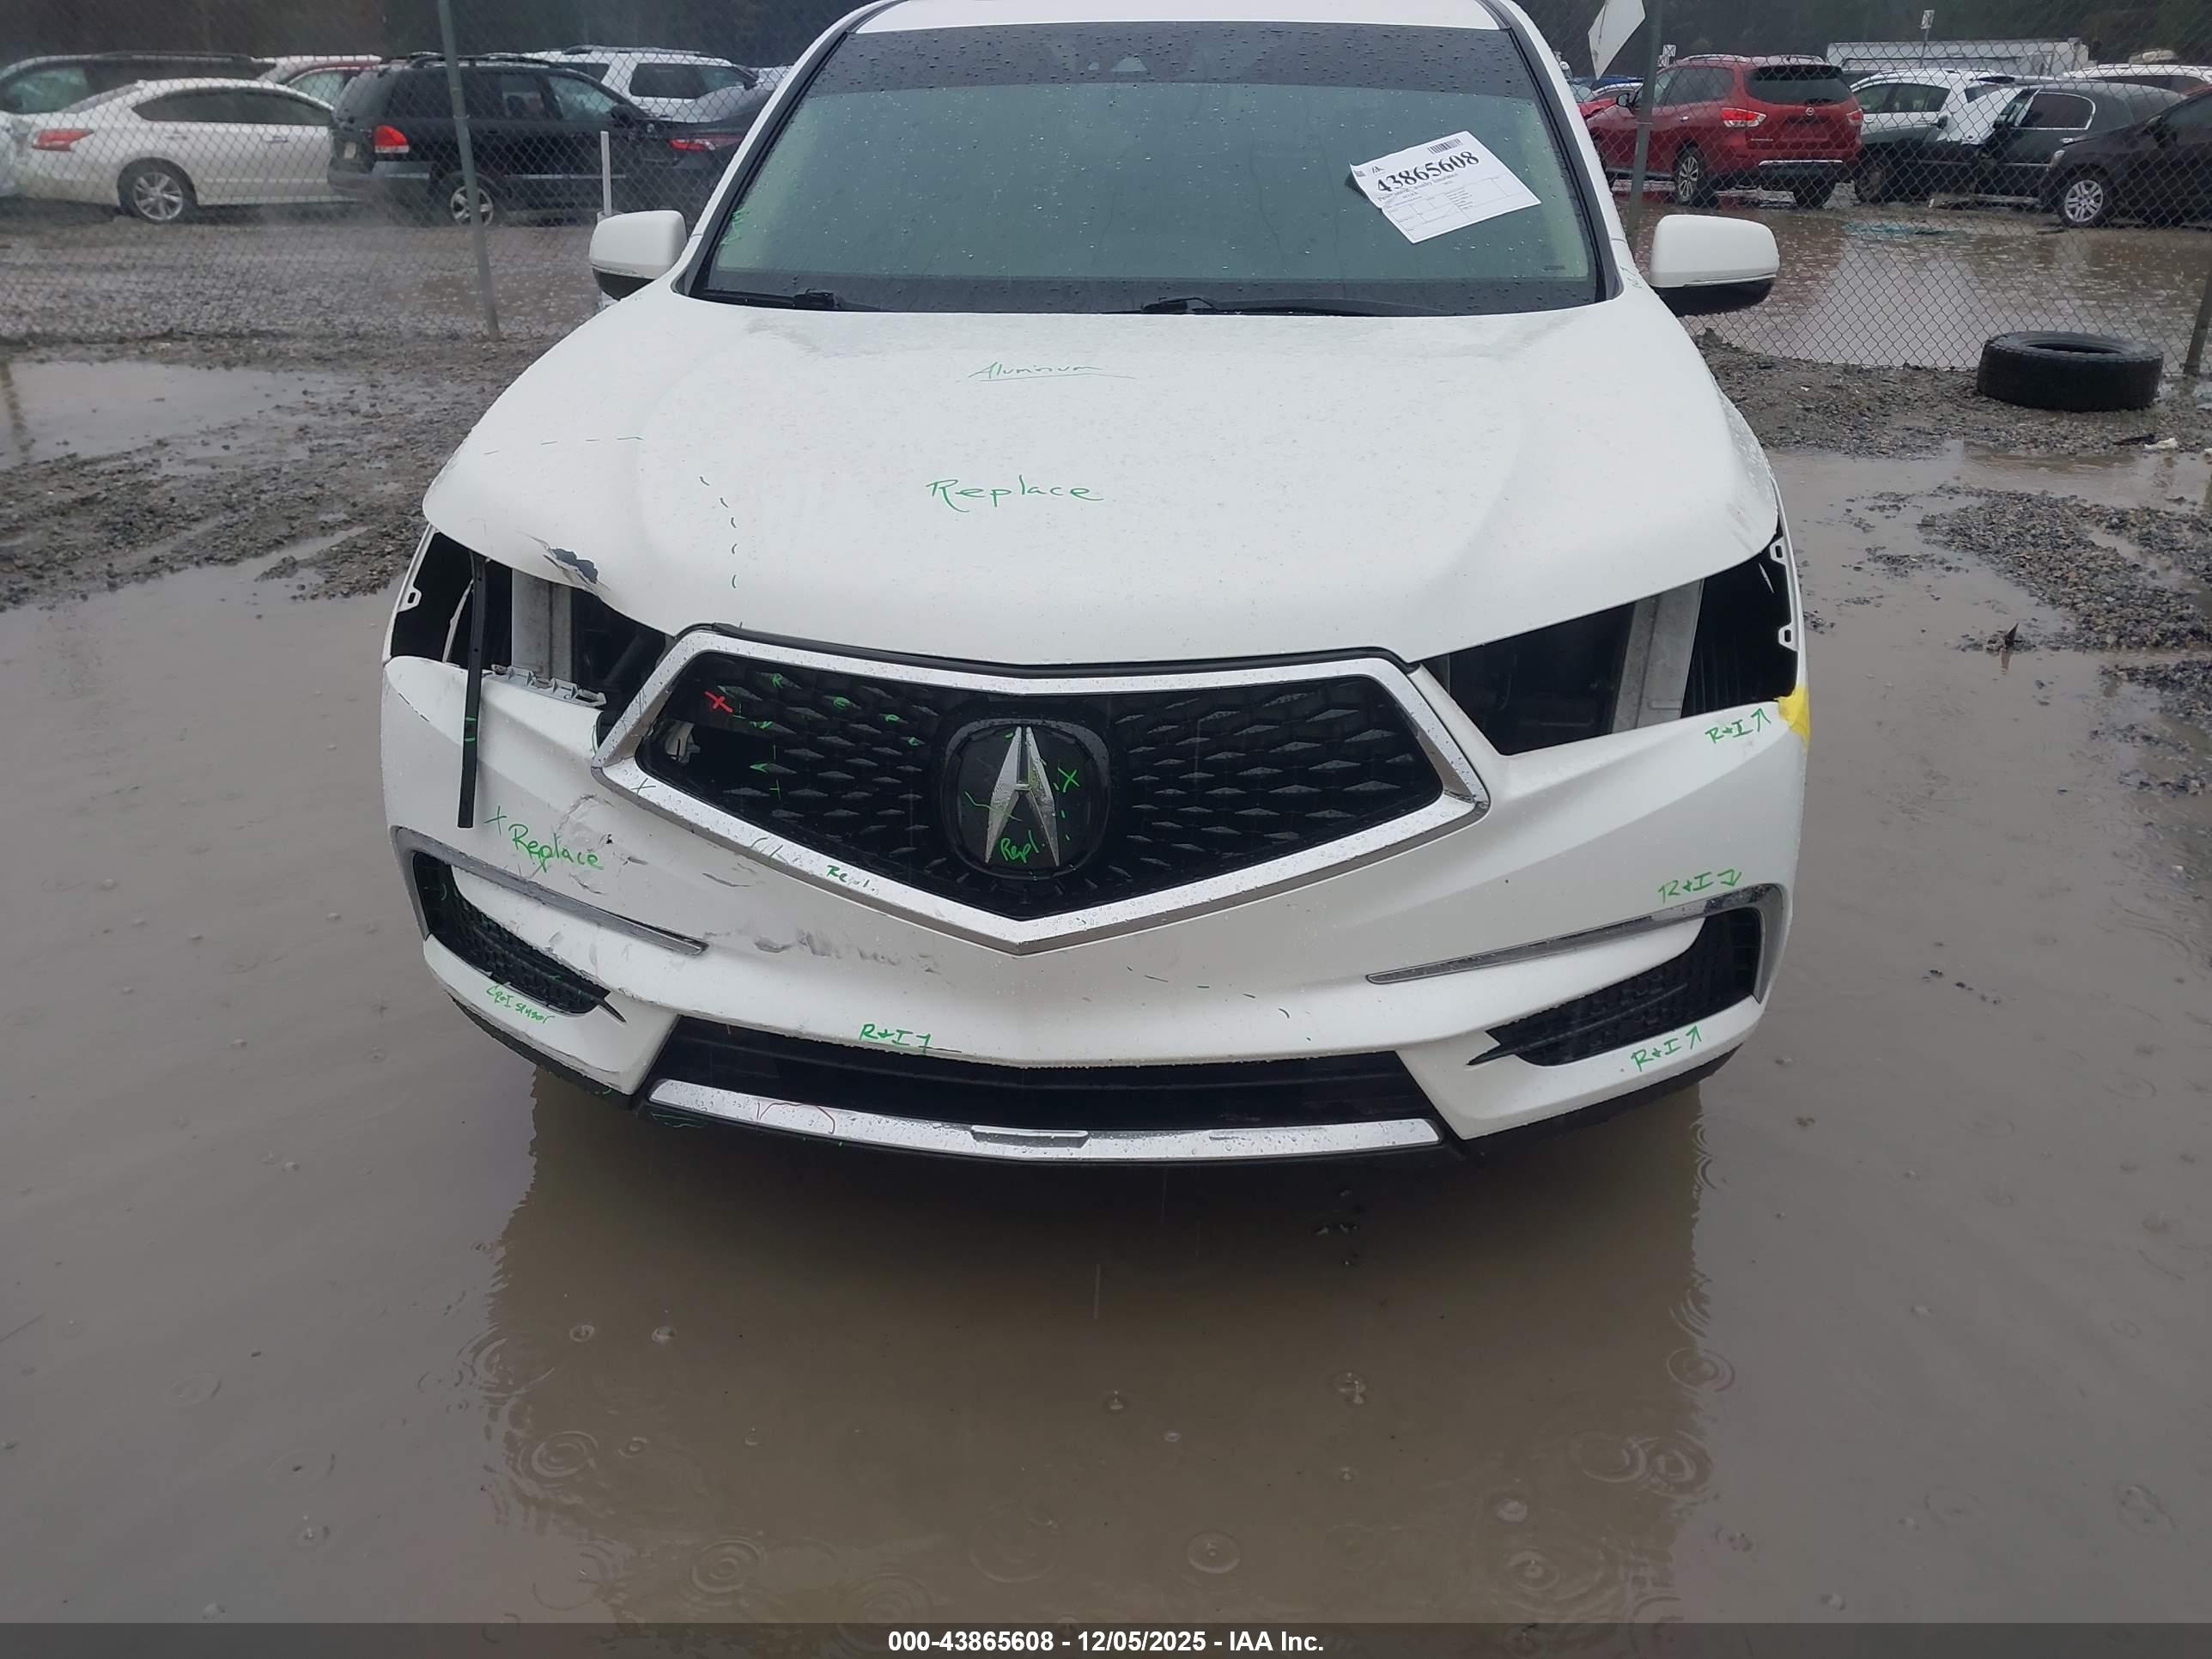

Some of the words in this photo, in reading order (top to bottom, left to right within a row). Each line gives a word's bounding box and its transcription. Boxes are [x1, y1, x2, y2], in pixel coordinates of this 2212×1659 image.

[1376, 151, 1479, 193] 43865608
[926, 475, 1104, 513] Replace
[508, 823, 604, 872] Replace
